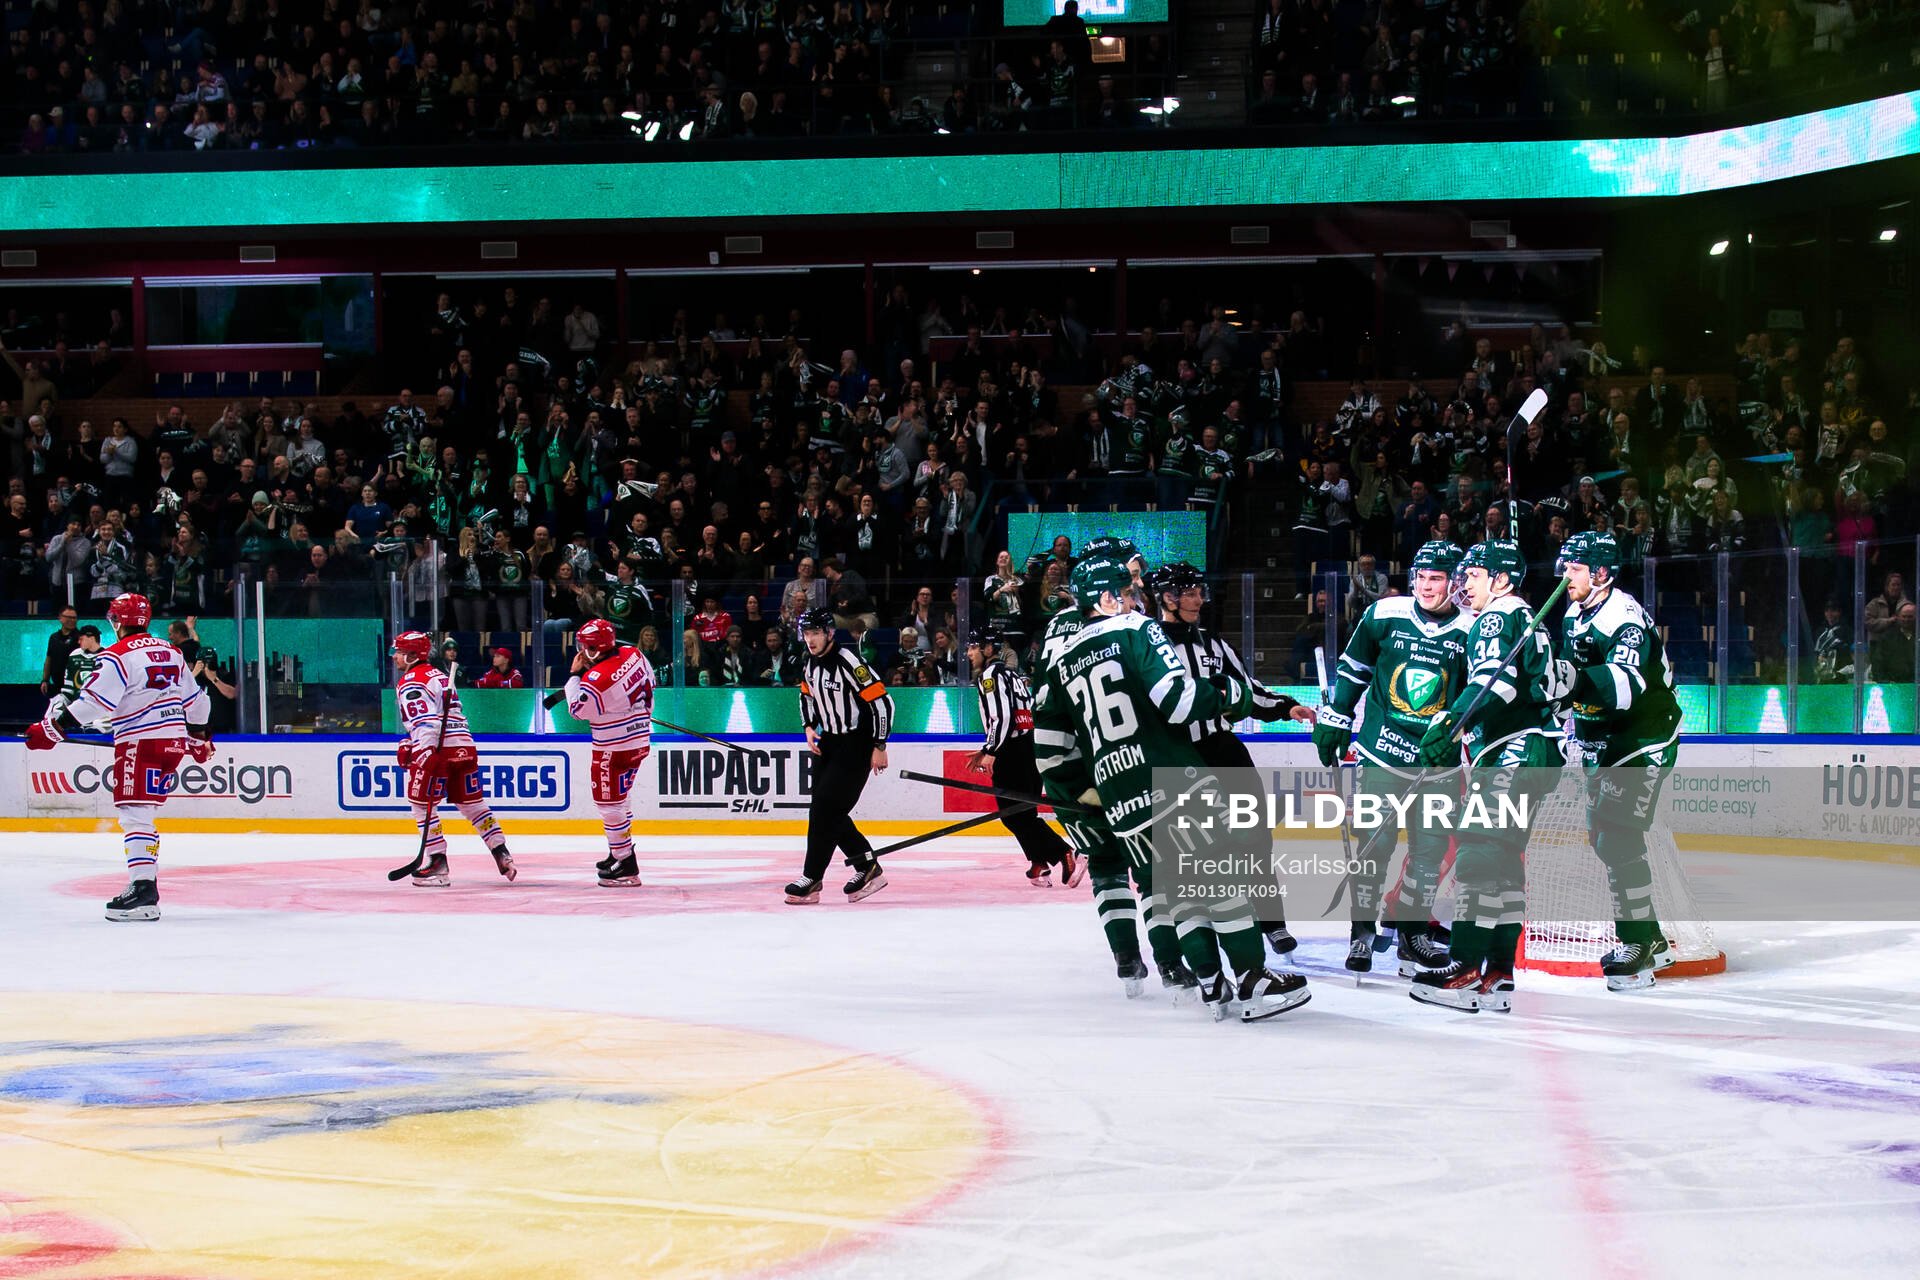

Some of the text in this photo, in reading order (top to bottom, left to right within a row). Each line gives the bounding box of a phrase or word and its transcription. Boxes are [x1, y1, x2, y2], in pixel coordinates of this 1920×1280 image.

[1071, 642, 1121, 677] Infrakraft
[1474, 638, 1500, 660] 34
[825, 681, 840, 690] SHL
[407, 700, 428, 718] 63
[1066, 660, 1139, 757] 26
[1322, 711, 1352, 728] CCM
[1375, 739, 1416, 763] Energi
[658, 750, 791, 796] IMPACT
[1672, 773, 1771, 793] Brand merch
[731, 799, 770, 813] SHL
[1672, 795, 1757, 819] made easy
